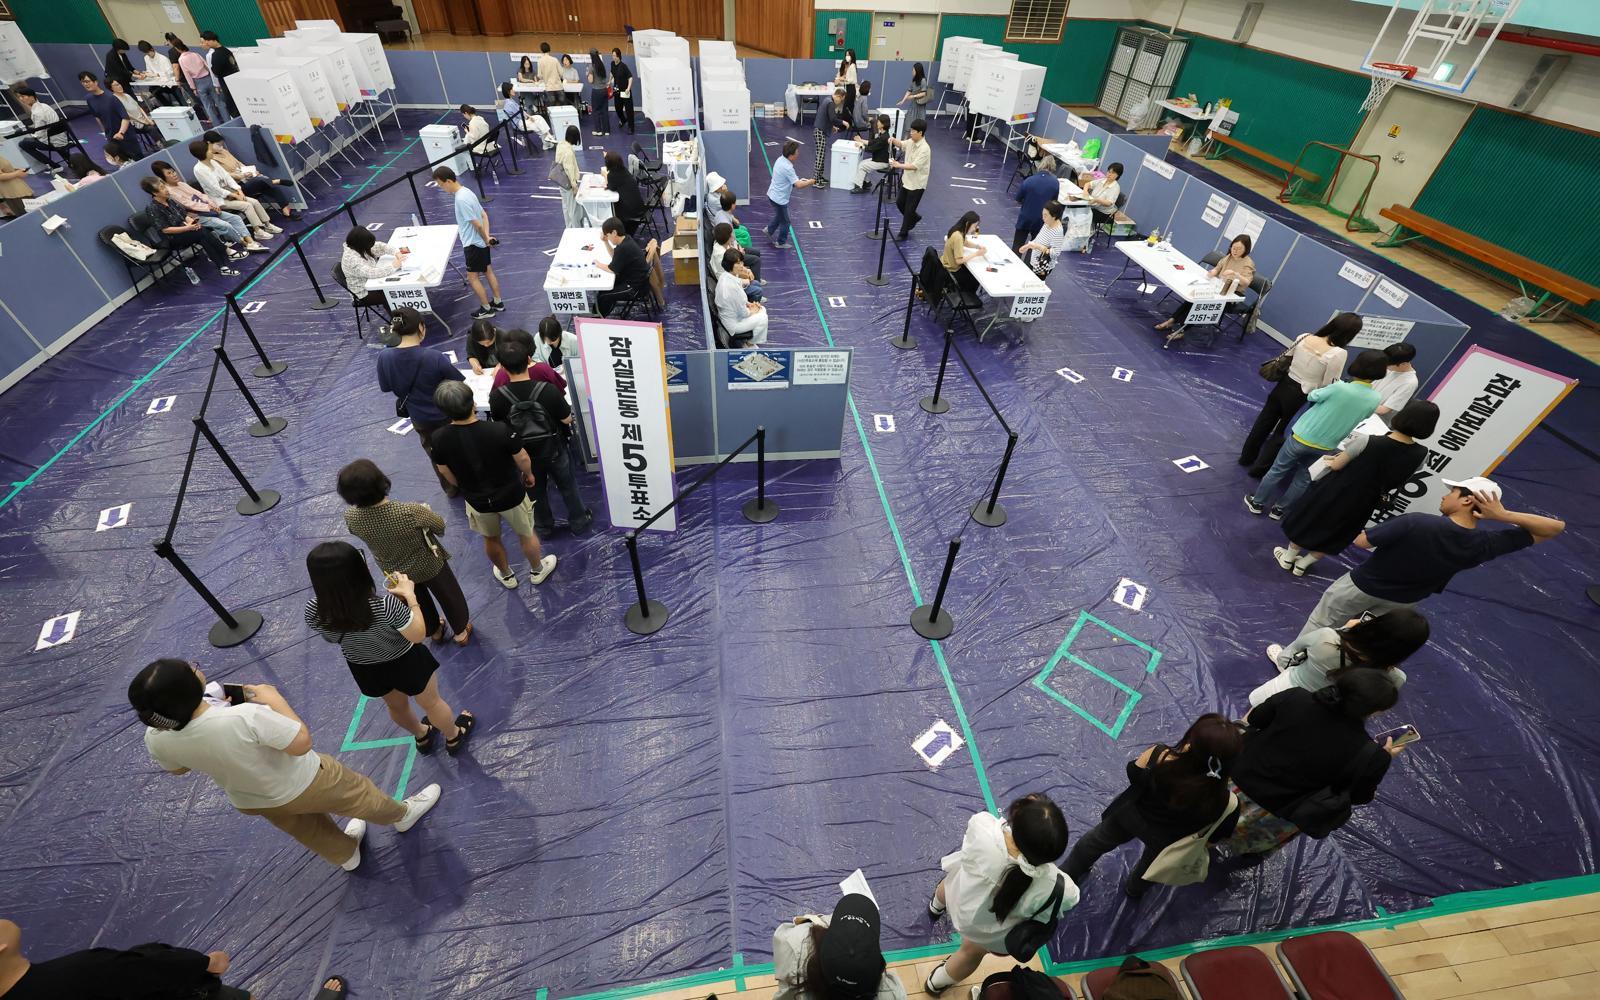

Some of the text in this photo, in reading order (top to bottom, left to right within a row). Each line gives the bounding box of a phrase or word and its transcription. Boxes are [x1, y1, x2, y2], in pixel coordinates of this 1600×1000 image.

[388, 289, 424, 299] 등재번호
[551, 291, 584, 300] 등재번호
[1017, 296, 1046, 305] 등재번호
[1014, 306, 1043, 316] 1~2150
[1194, 303, 1223, 312] 등재번호
[608, 336, 639, 419] 잠실본동
[1437, 372, 1522, 452] 잠실본동
